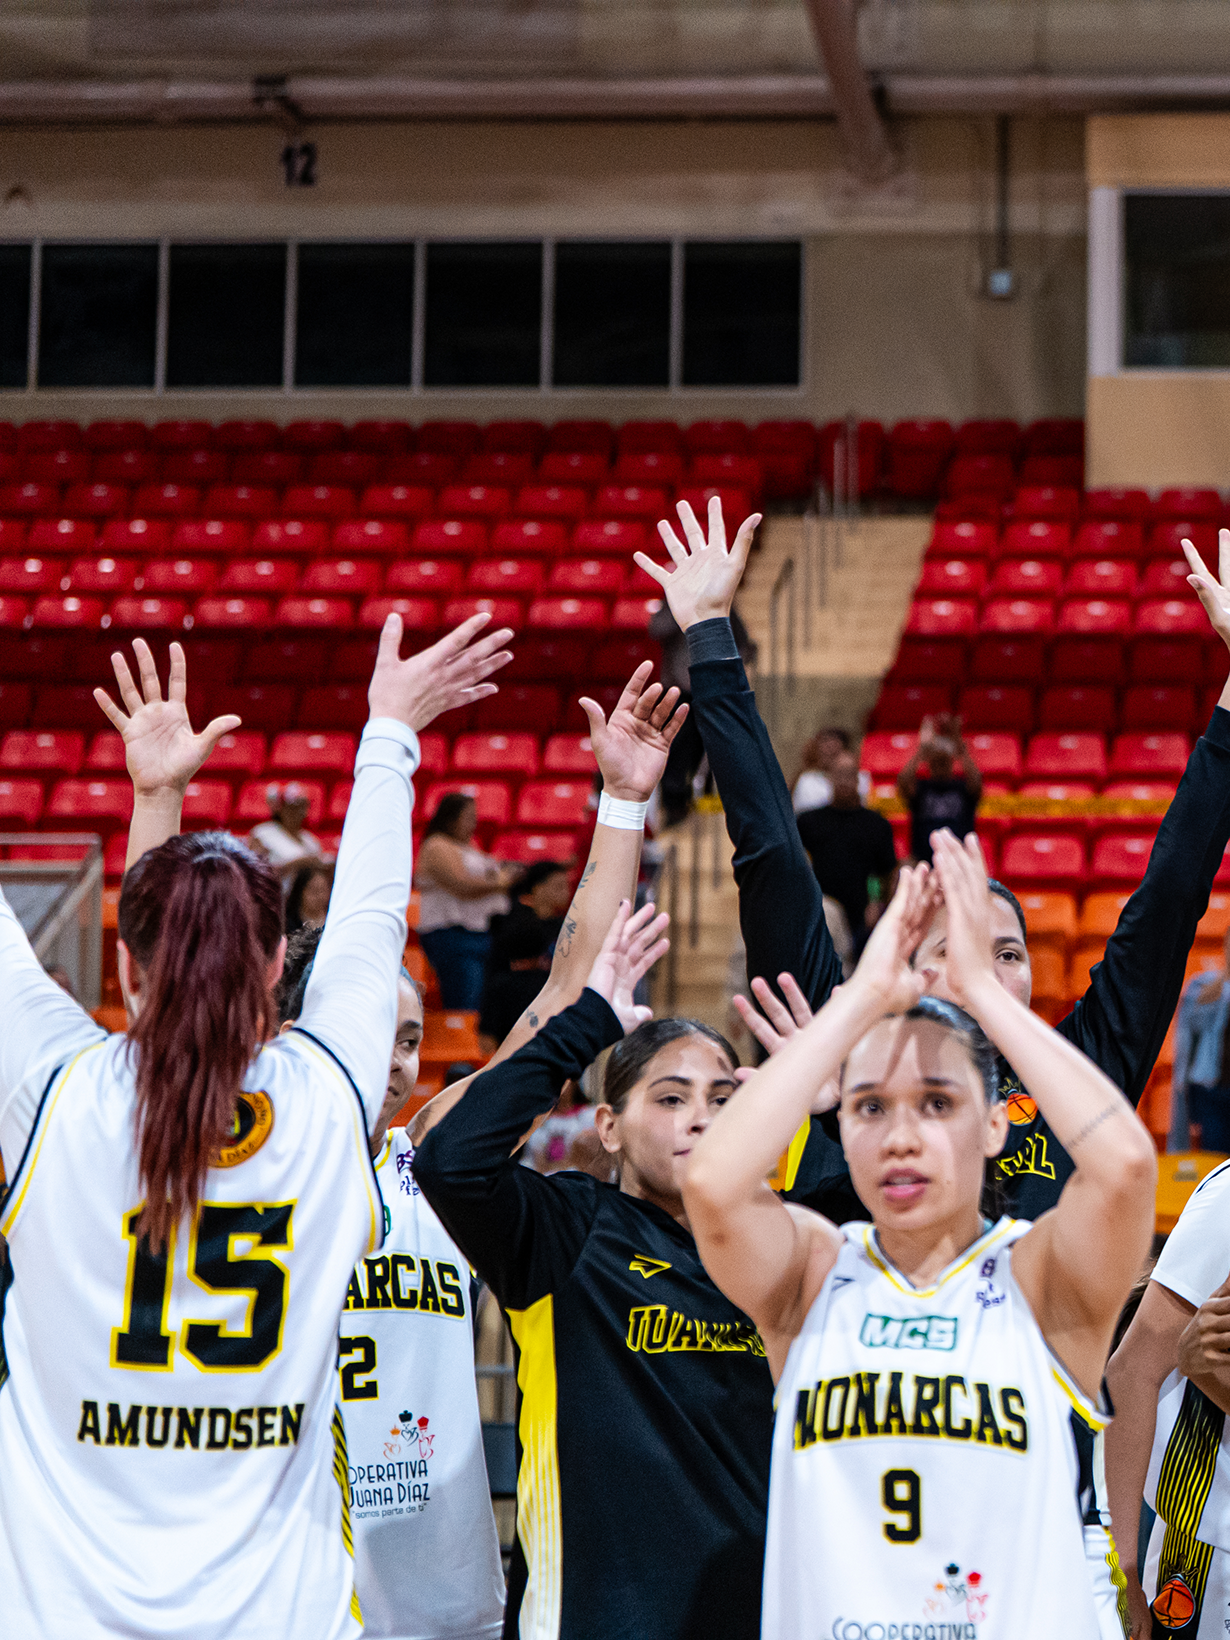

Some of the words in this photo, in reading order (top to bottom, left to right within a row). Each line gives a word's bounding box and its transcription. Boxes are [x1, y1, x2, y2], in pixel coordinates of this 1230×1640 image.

[281, 143, 317, 187] 12
[109, 1198, 298, 1374] 15
[859, 1313, 958, 1352] MCS
[77, 1399, 305, 1452] AMUNDSEN
[793, 1370, 1028, 1454] MONARCAS
[349, 1485, 394, 1508] JUANA
[396, 1480, 431, 1504] DÍAZ
[381, 1506, 404, 1519] parte
[405, 1504, 417, 1513] de
[878, 1467, 922, 1545] 9
